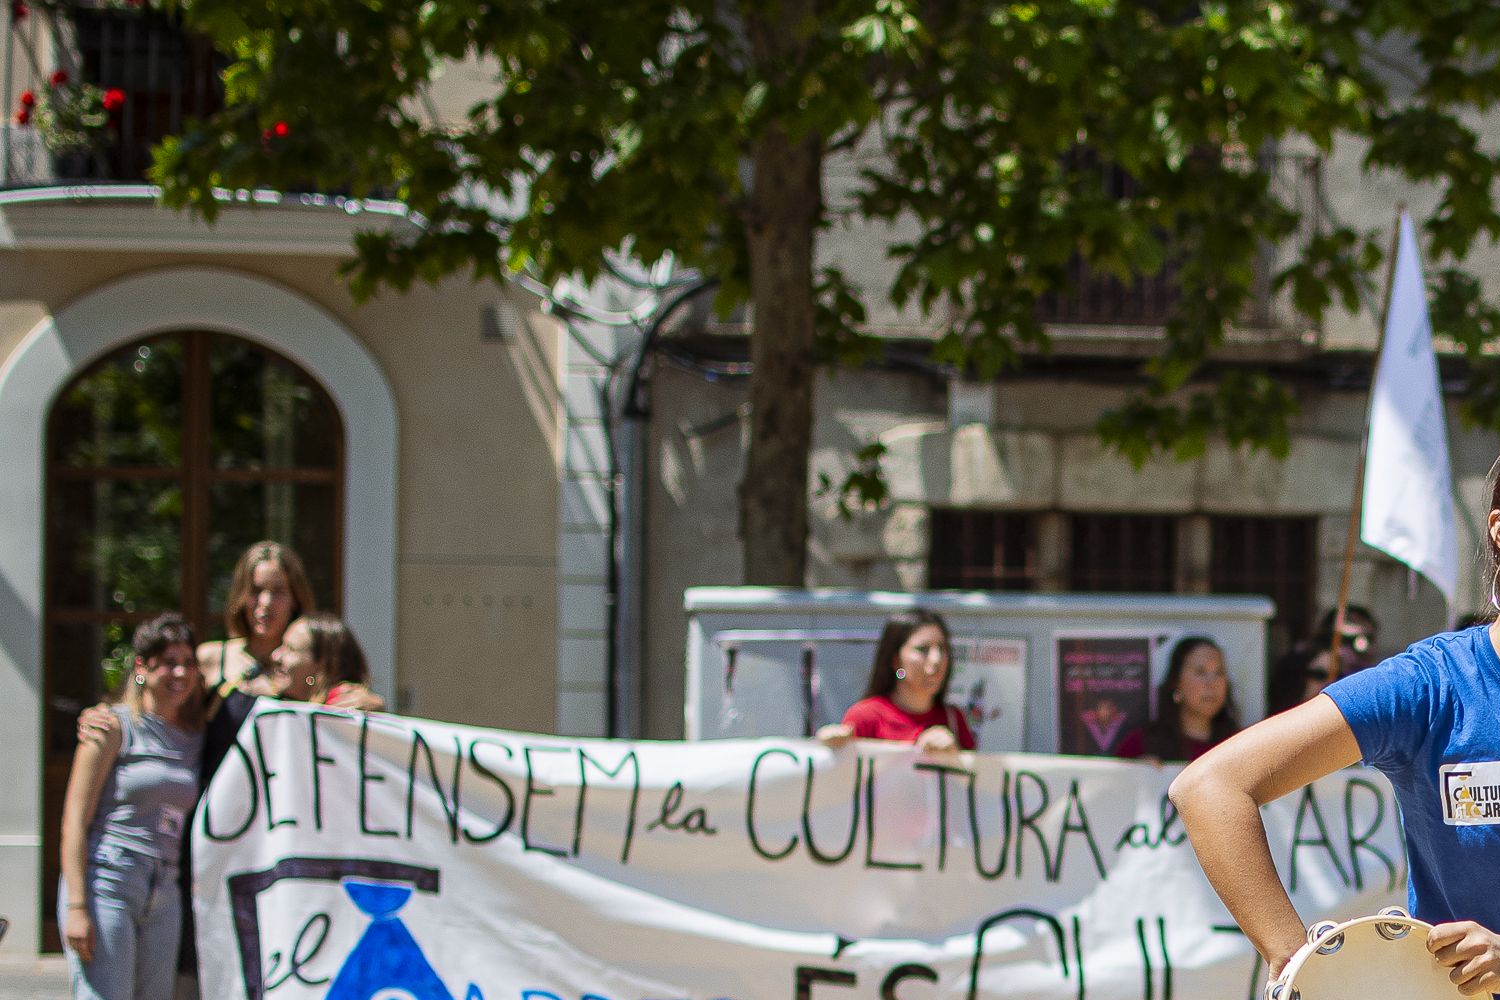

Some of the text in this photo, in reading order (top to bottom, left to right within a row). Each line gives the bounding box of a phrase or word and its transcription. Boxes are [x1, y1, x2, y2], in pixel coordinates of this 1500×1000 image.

[203, 706, 643, 865] DEFENSEM
[646, 780, 717, 837] la
[747, 749, 1107, 882] CULTURA
